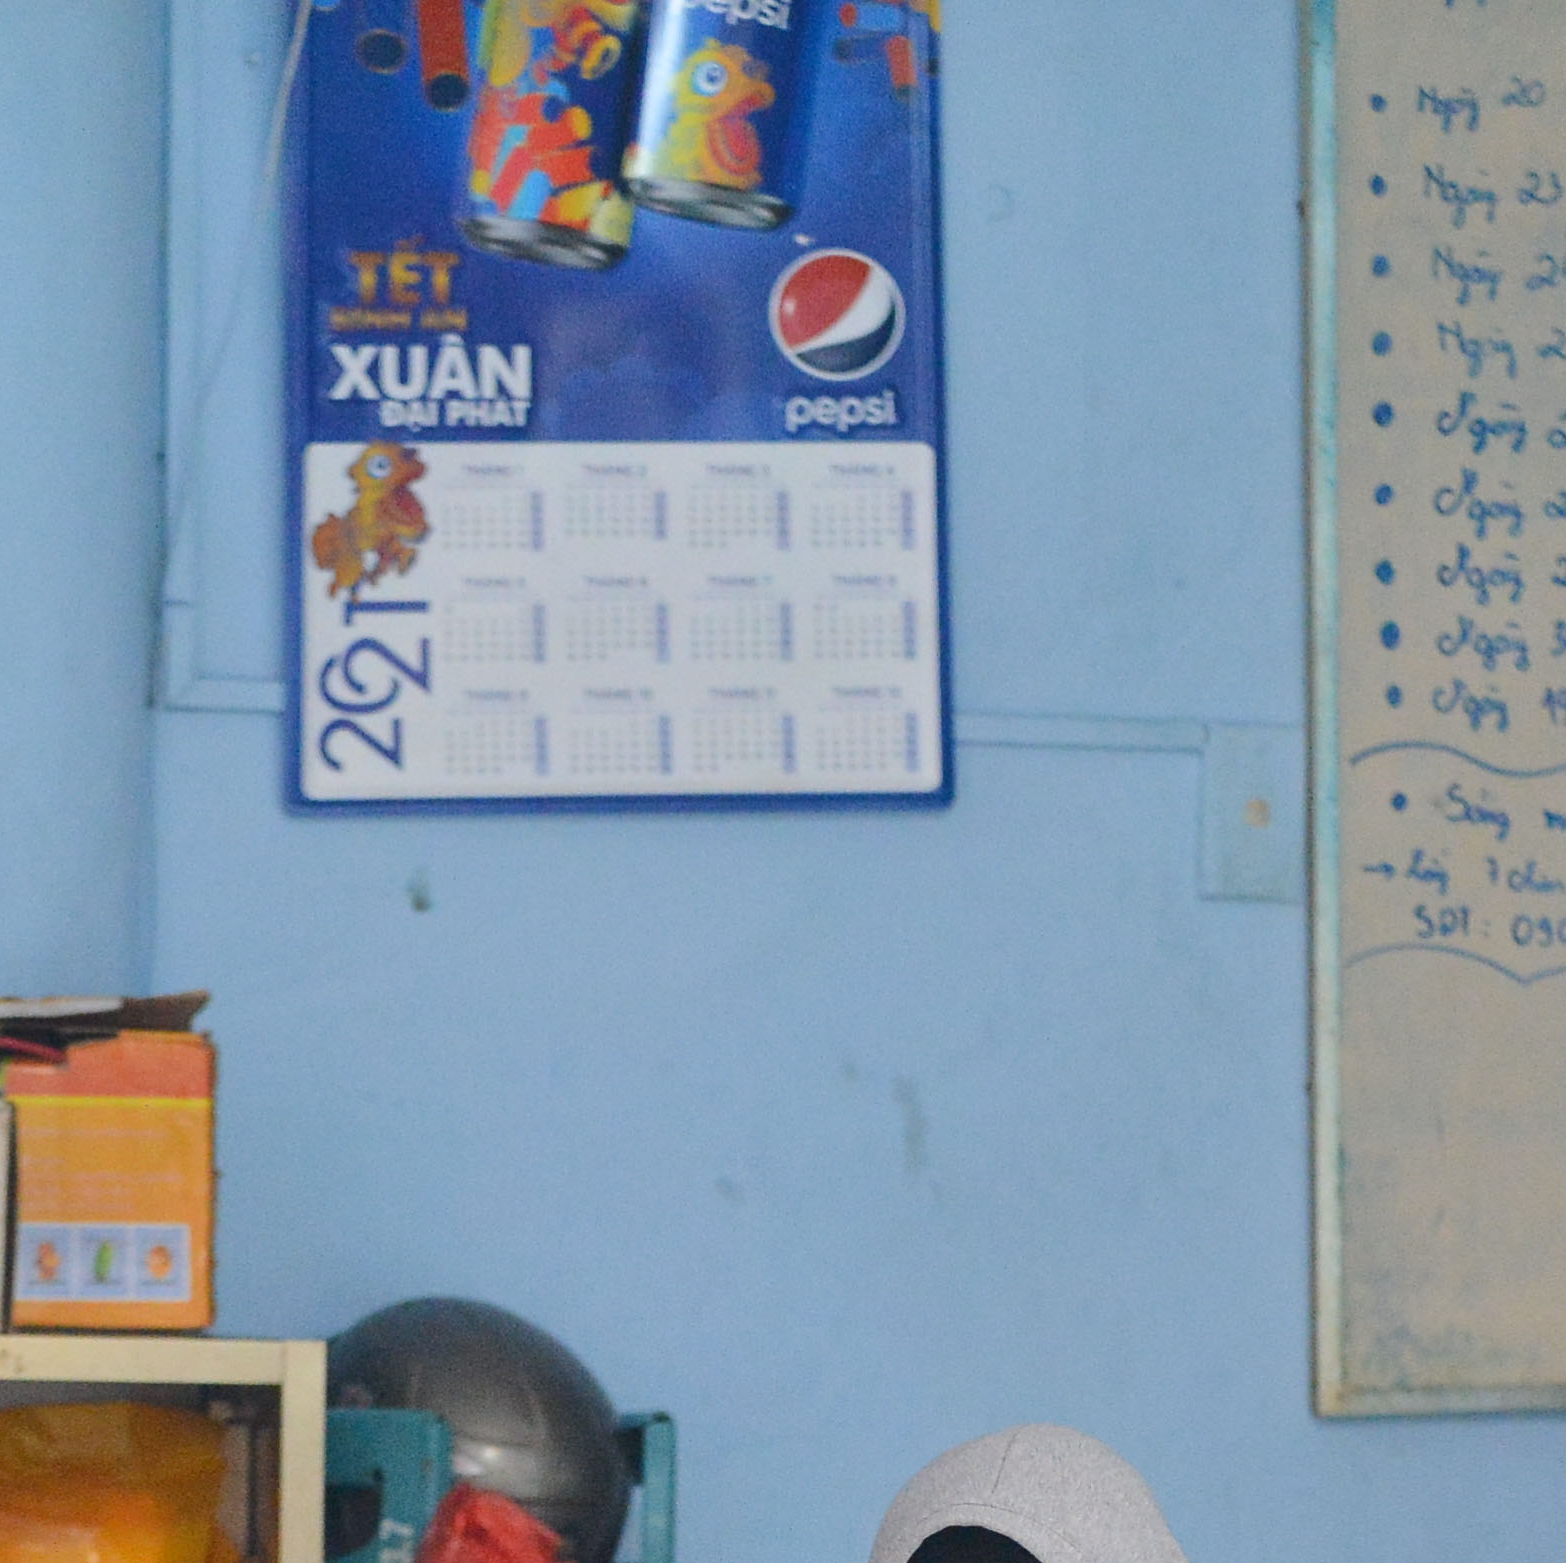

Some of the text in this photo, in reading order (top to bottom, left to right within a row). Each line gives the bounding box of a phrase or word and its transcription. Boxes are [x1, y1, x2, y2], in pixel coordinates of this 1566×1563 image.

[349, 235, 461, 305] TẾT
[328, 332, 533, 400] XUÂN
[785, 389, 899, 433] pepsi
